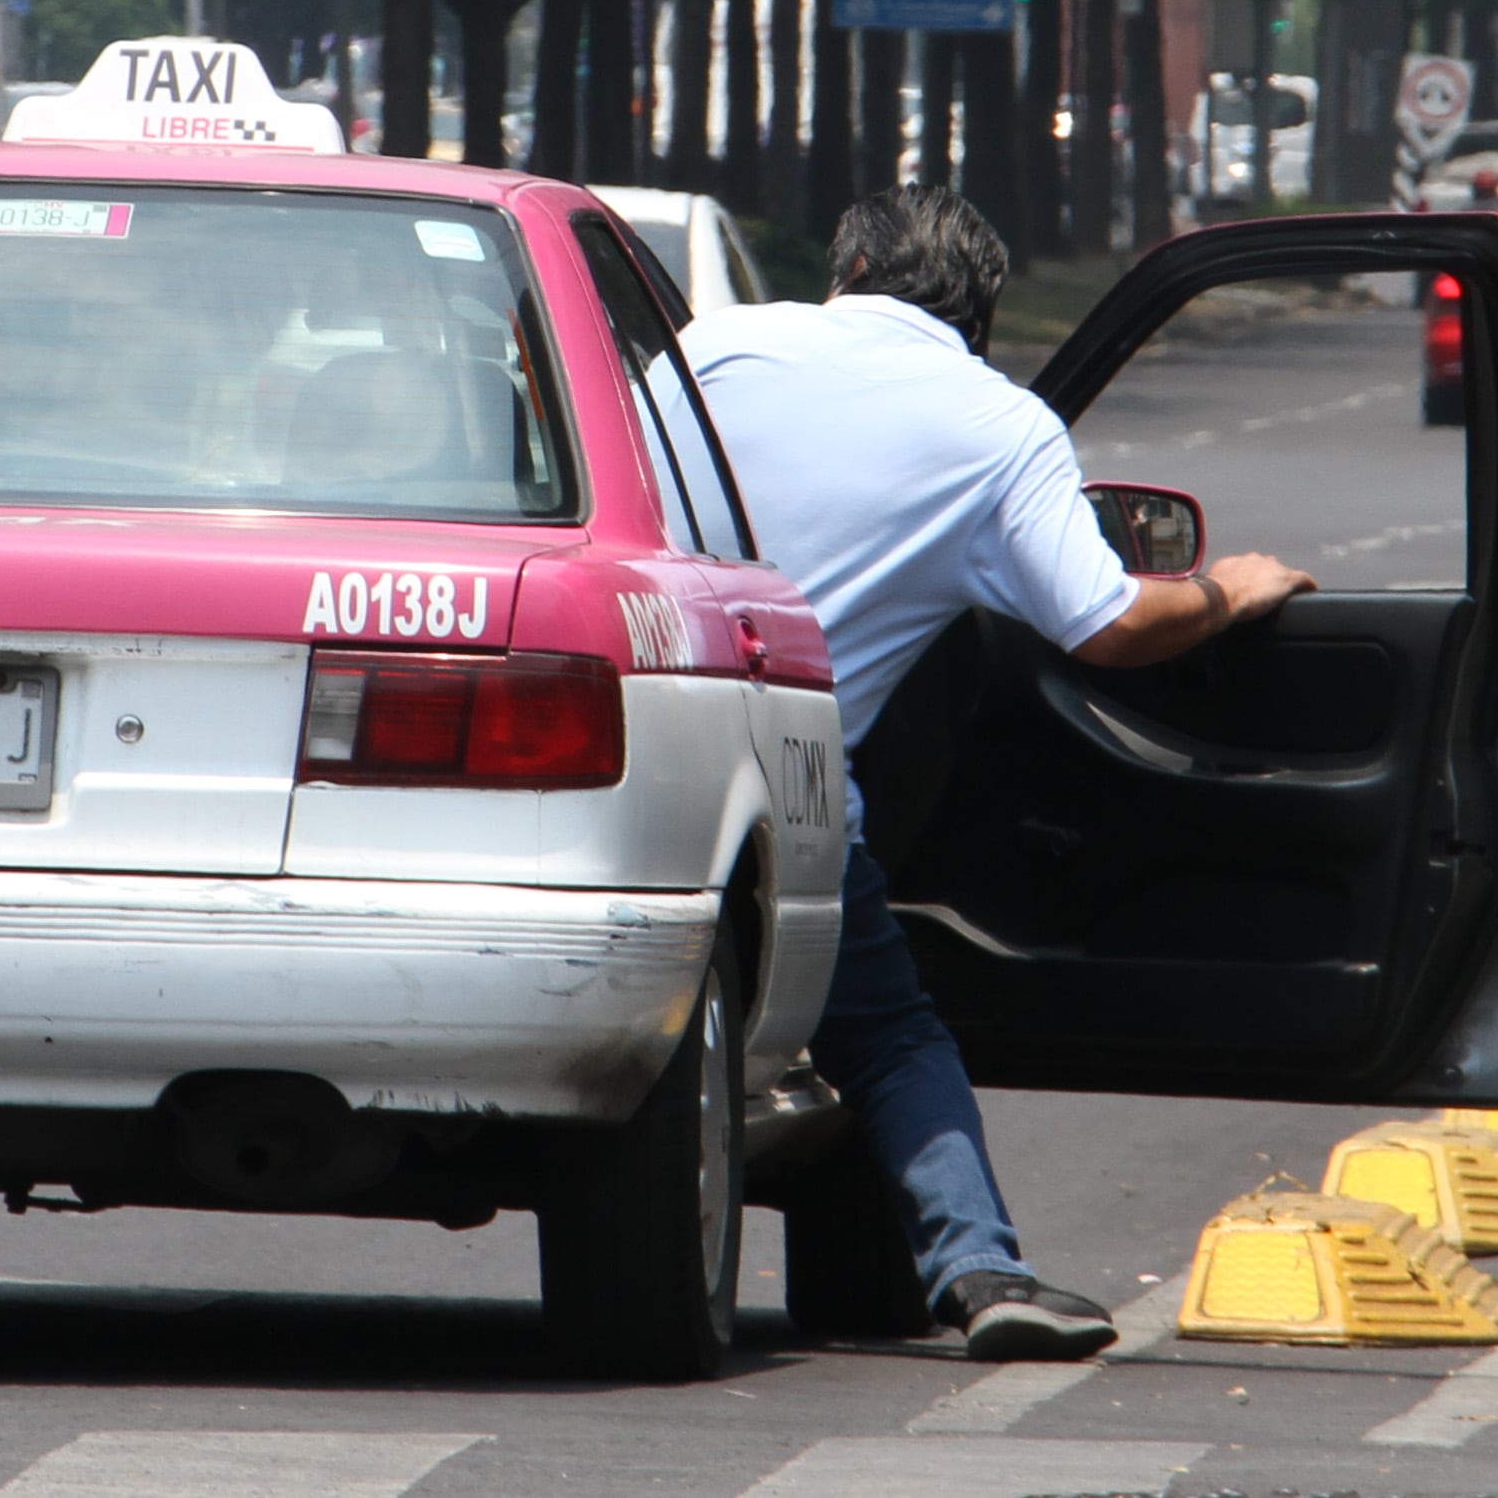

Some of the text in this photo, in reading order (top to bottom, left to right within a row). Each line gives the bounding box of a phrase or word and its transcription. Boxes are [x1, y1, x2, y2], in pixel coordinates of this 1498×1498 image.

[120, 49, 236, 103] TAXI
[142, 116, 230, 139] LIBRE
[302, 571, 487, 639] A0138J
[781, 736, 830, 829] CDMX
